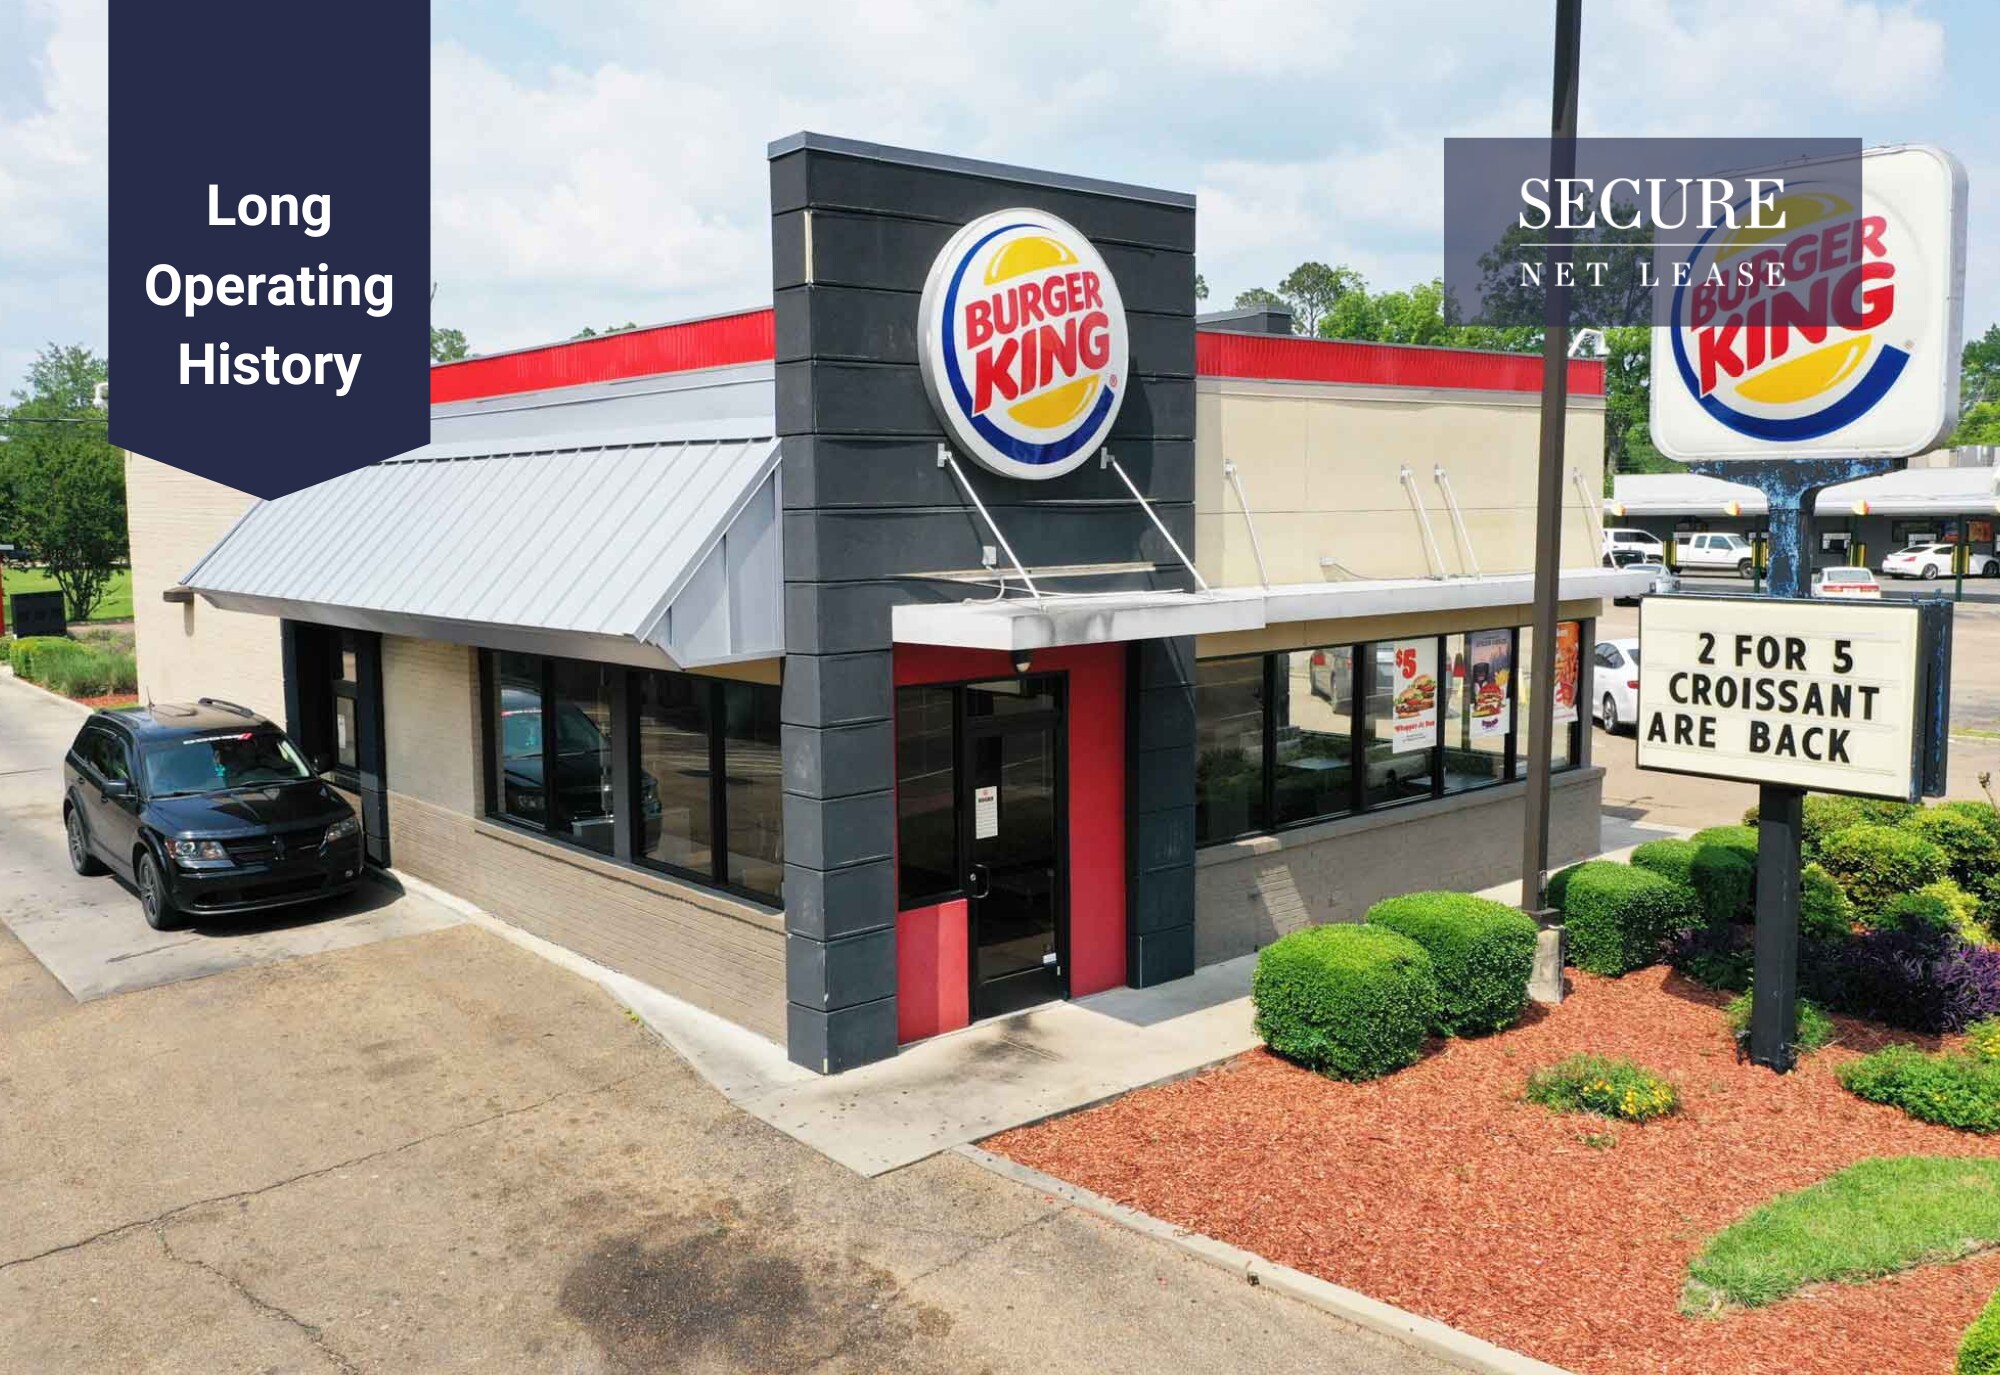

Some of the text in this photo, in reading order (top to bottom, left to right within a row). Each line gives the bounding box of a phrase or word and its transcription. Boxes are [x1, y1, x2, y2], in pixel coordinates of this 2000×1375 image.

[1691, 215, 1887, 331] BURGER
[965, 271, 1103, 350] BURGER
[1699, 261, 1895, 395] KING
[974, 311, 1110, 414] KING
[1395, 648, 1417, 679] $5
[1698, 632, 1853, 674] 2 FOR 5
[1669, 672, 1880, 720] CROISSANT
[1647, 711, 1851, 763] ARE BACK
